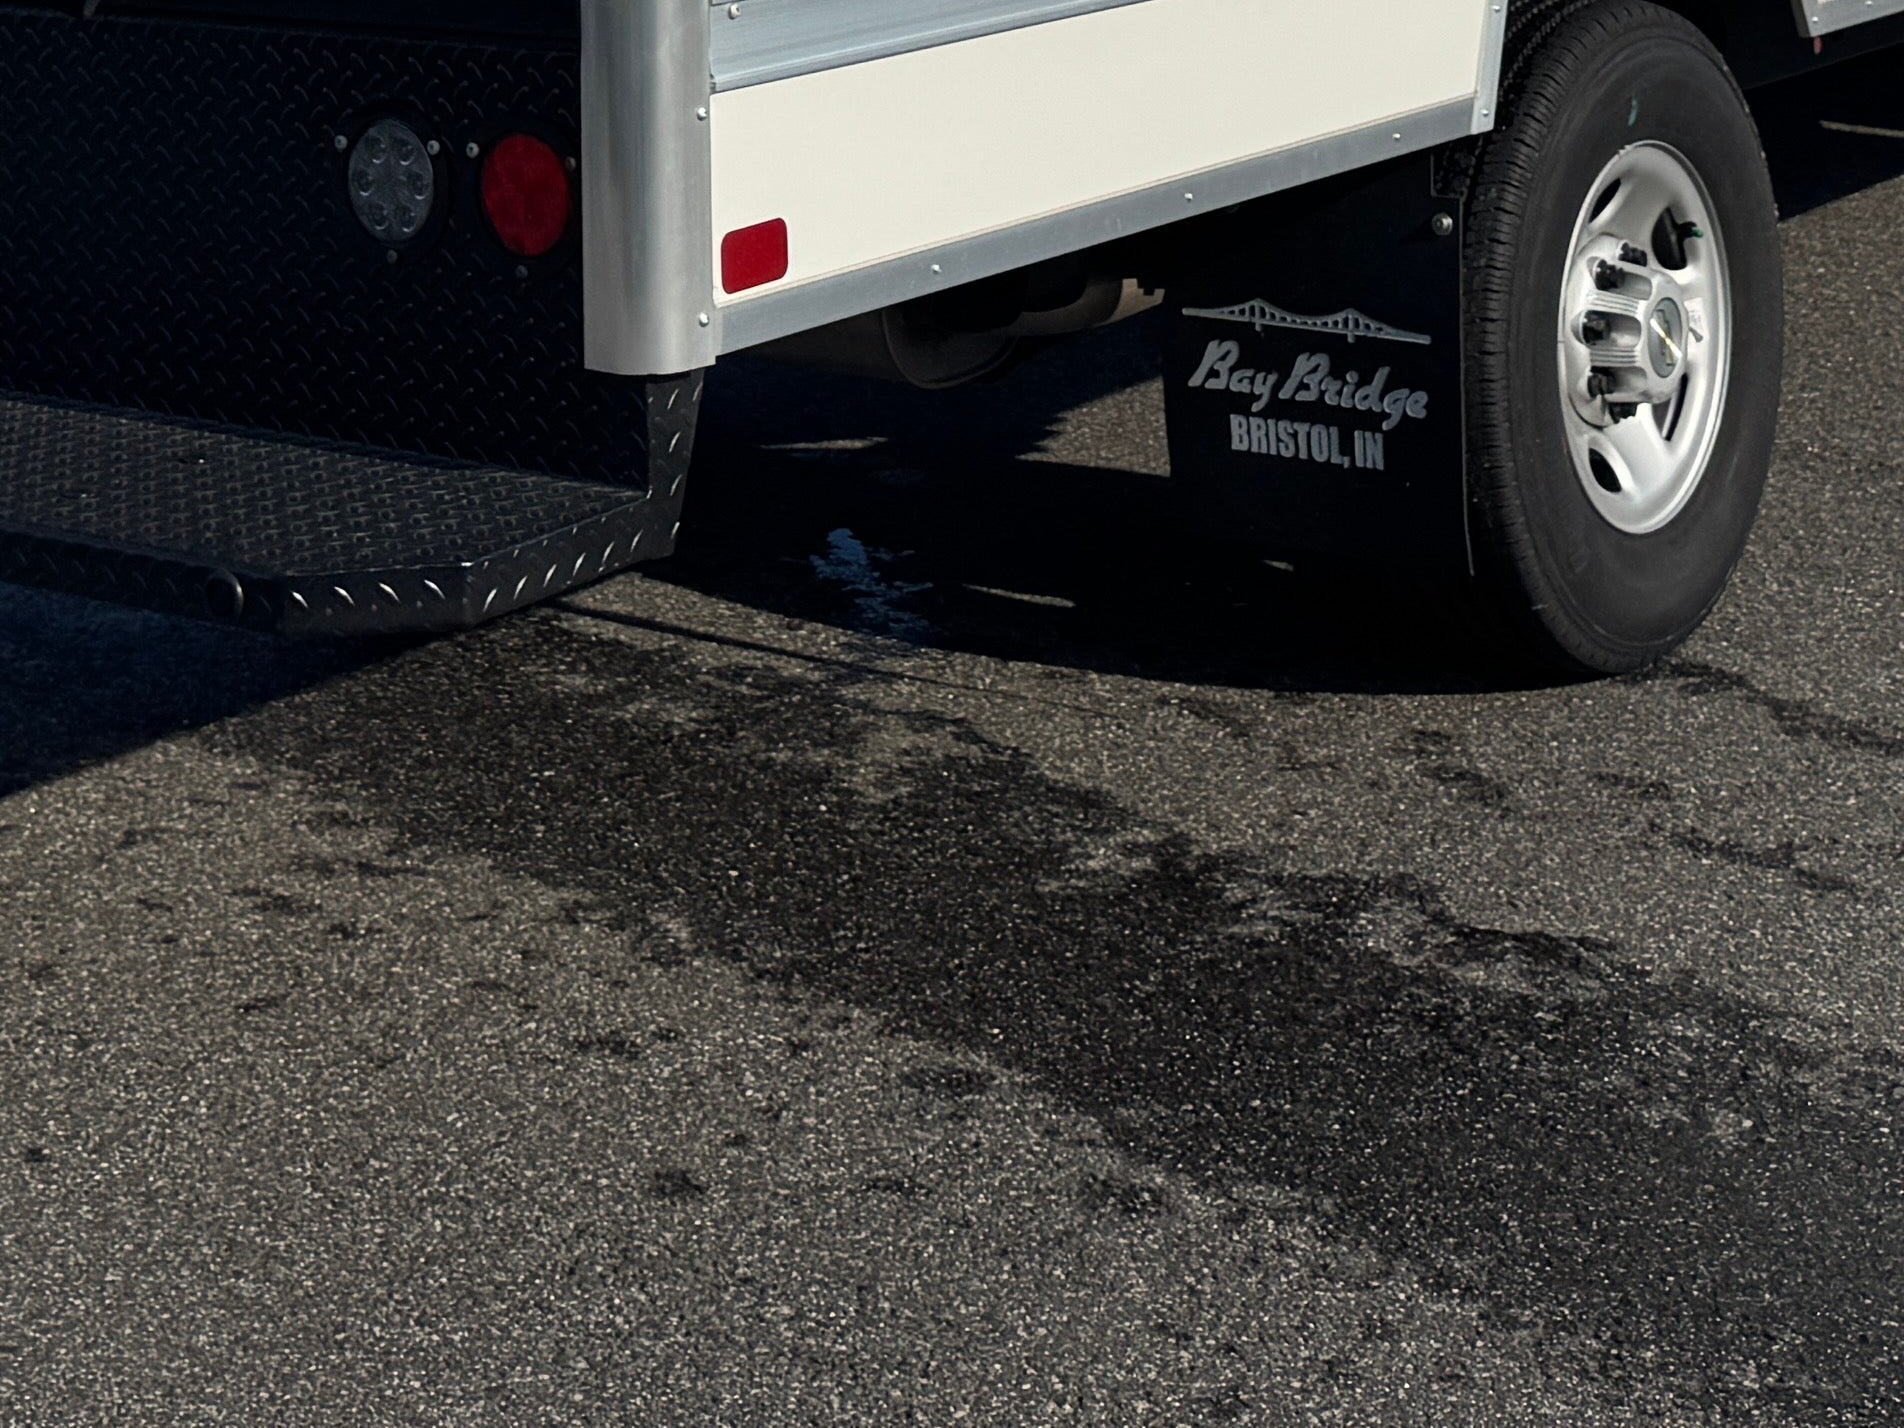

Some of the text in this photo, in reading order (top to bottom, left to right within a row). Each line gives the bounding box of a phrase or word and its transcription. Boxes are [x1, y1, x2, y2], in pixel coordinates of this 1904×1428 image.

[1188, 340, 1428, 431] Bay Bridge
[1230, 414, 1384, 471] BRISTOL, IN
